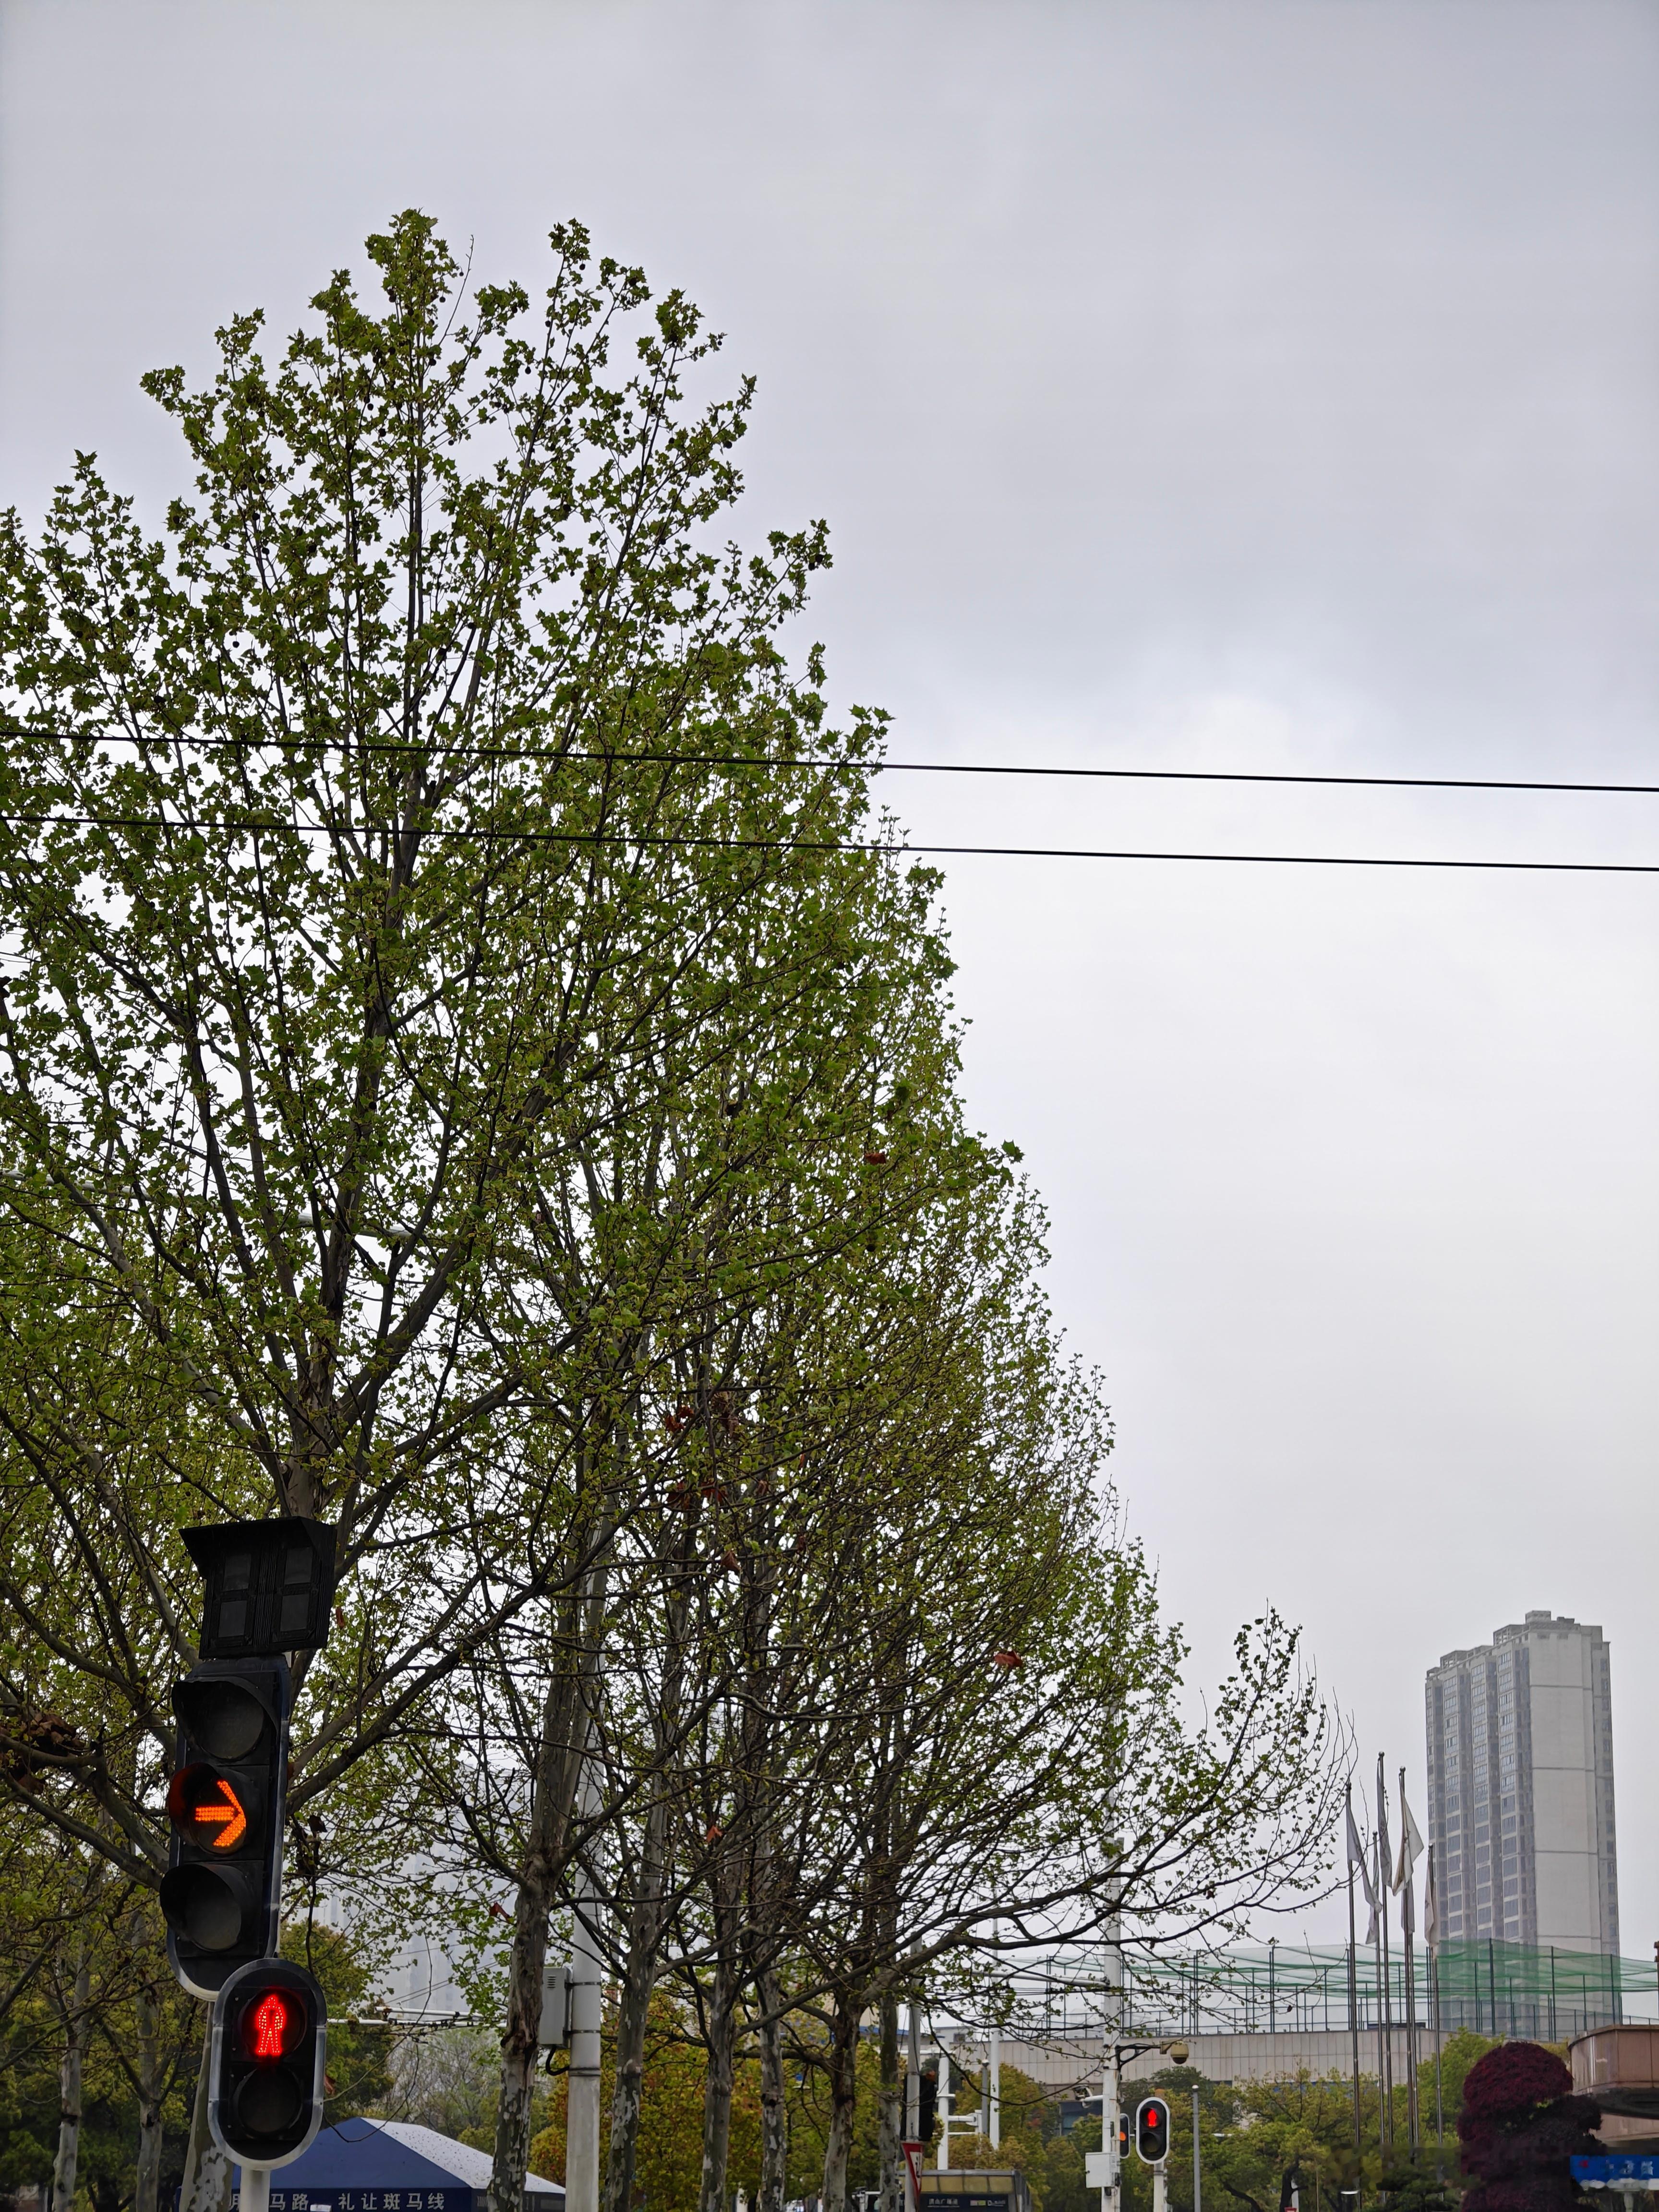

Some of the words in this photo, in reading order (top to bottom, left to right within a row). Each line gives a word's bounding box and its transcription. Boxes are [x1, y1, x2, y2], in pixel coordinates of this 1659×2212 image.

[338, 2192, 445, 2211] 礼让斑马线
